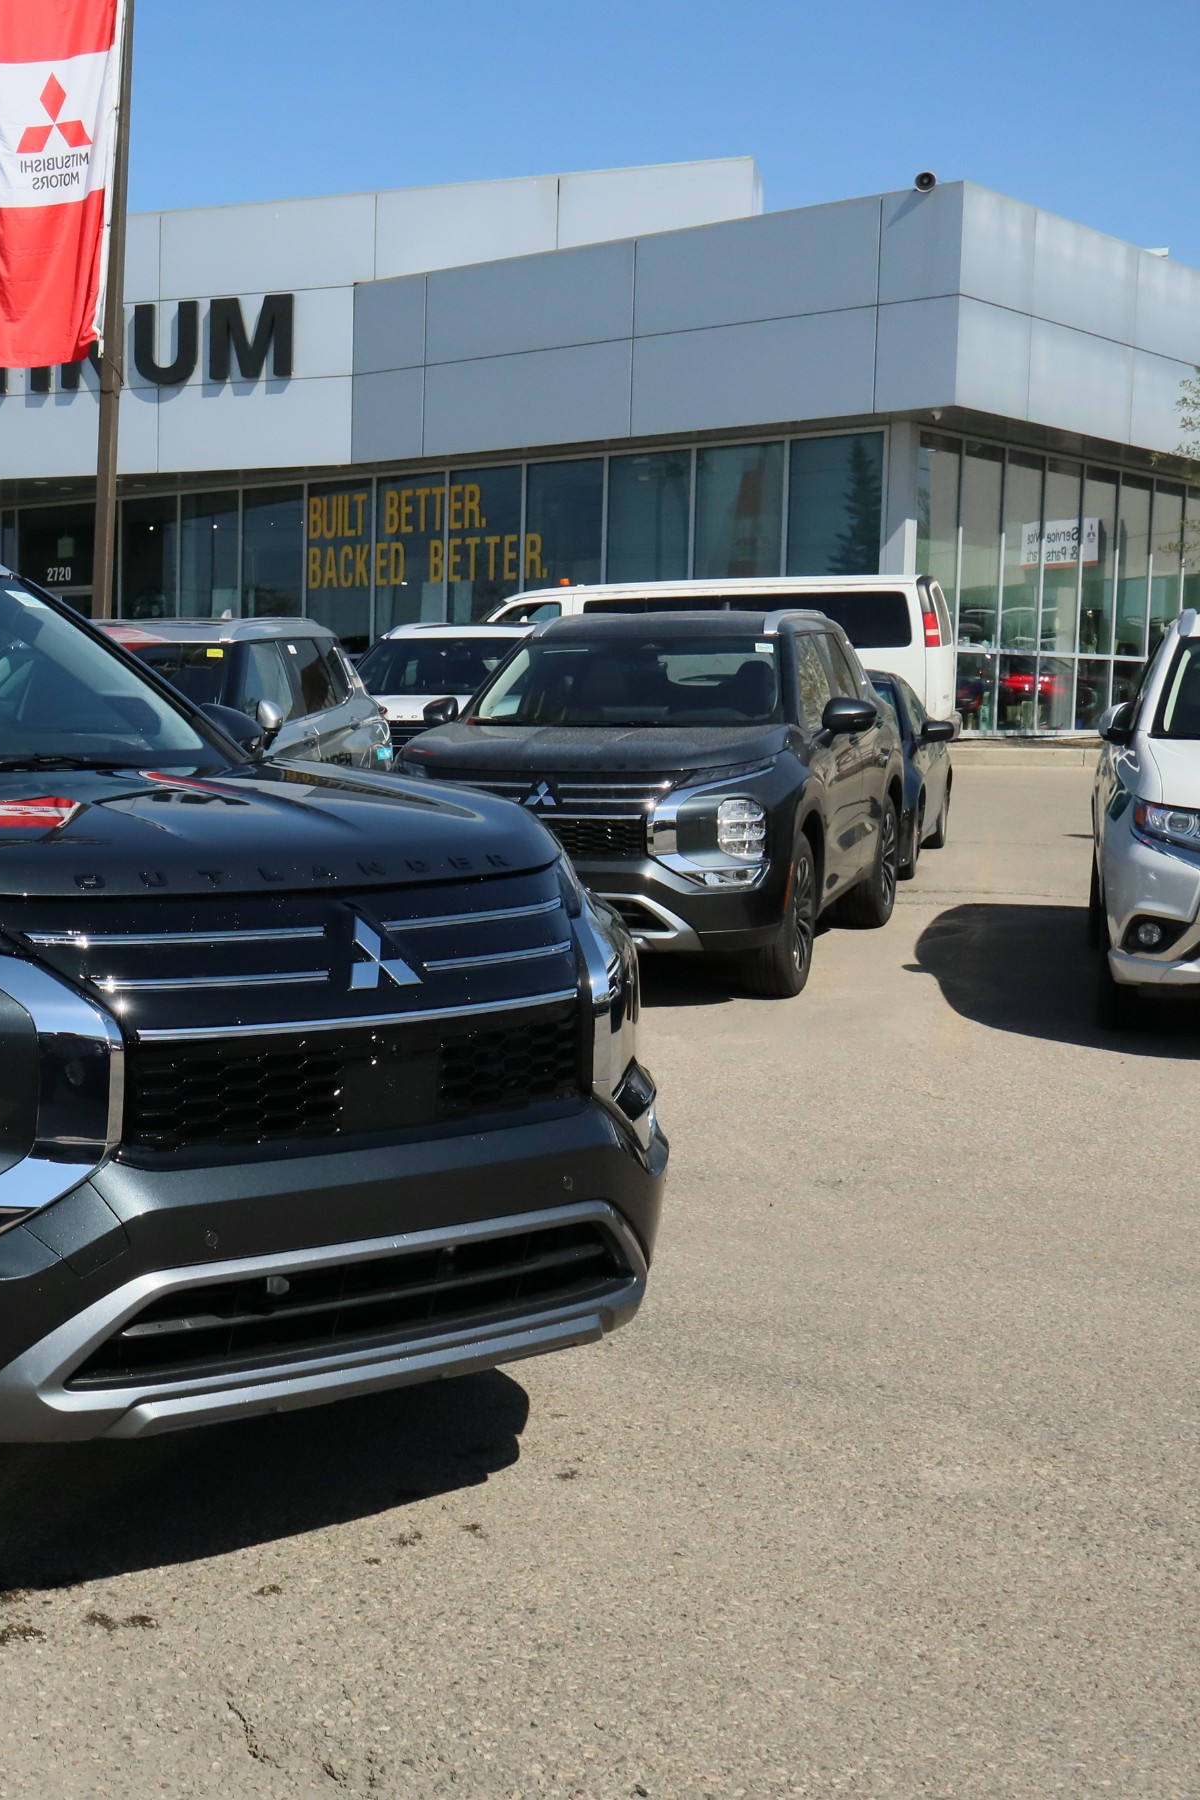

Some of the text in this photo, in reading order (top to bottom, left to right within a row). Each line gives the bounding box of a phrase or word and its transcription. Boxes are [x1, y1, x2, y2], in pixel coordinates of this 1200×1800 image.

[308, 483, 487, 540] BUILT BETTER.
[46, 566, 72, 582] 2720
[308, 533, 548, 590] BACKED BETTER.
[74, 854, 512, 890] OUTLANDER
